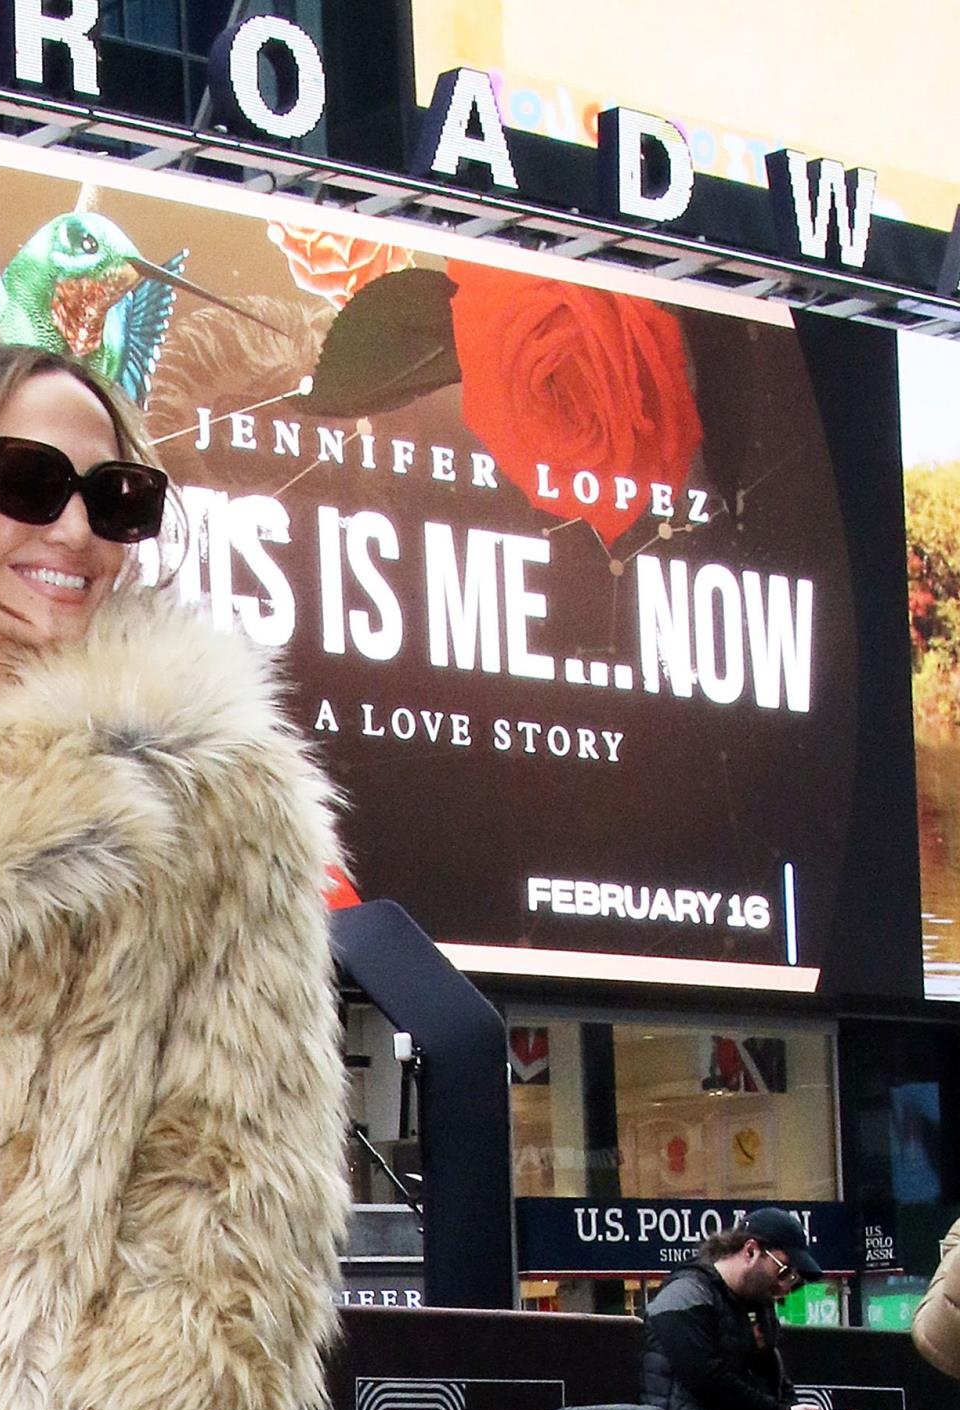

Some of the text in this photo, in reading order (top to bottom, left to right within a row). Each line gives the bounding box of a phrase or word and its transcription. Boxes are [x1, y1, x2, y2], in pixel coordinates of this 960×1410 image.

[194, 407, 709, 524] JENNIFER LOPEZ
[317, 505, 403, 662] IS
[313, 698, 625, 762] A LOVE STORY
[527, 876, 771, 930] FEBRUARY 16
[574, 1207, 631, 1243] U.S.
[637, 1207, 723, 1243] POLO
[865, 1236, 893, 1249] POLO
